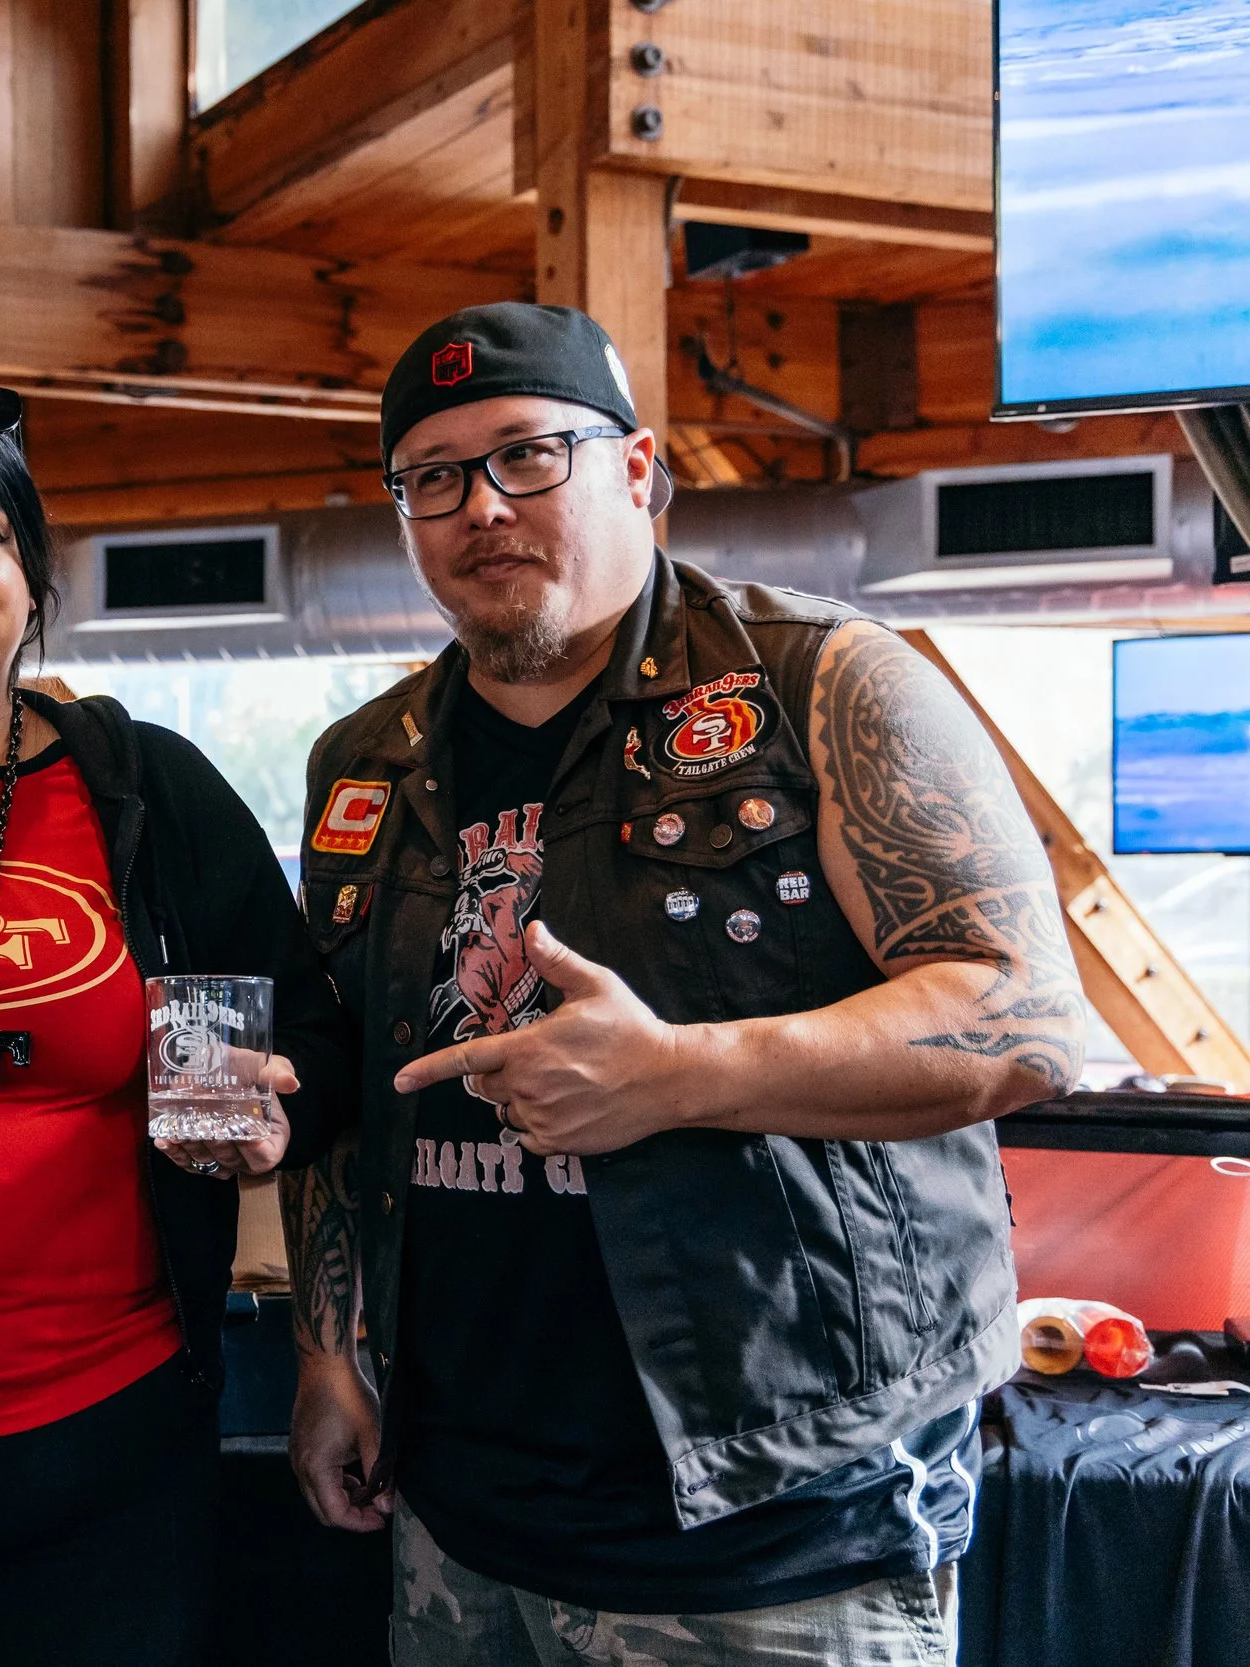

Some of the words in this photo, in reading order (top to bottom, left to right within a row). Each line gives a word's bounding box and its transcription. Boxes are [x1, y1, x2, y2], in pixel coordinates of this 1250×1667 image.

[678, 757, 728, 776] TAILGATE
[728, 743, 757, 764] CREW
[779, 877, 808, 889] RED
[780, 888, 810, 901] BAR
[410, 1138, 524, 1194] ILGATE
